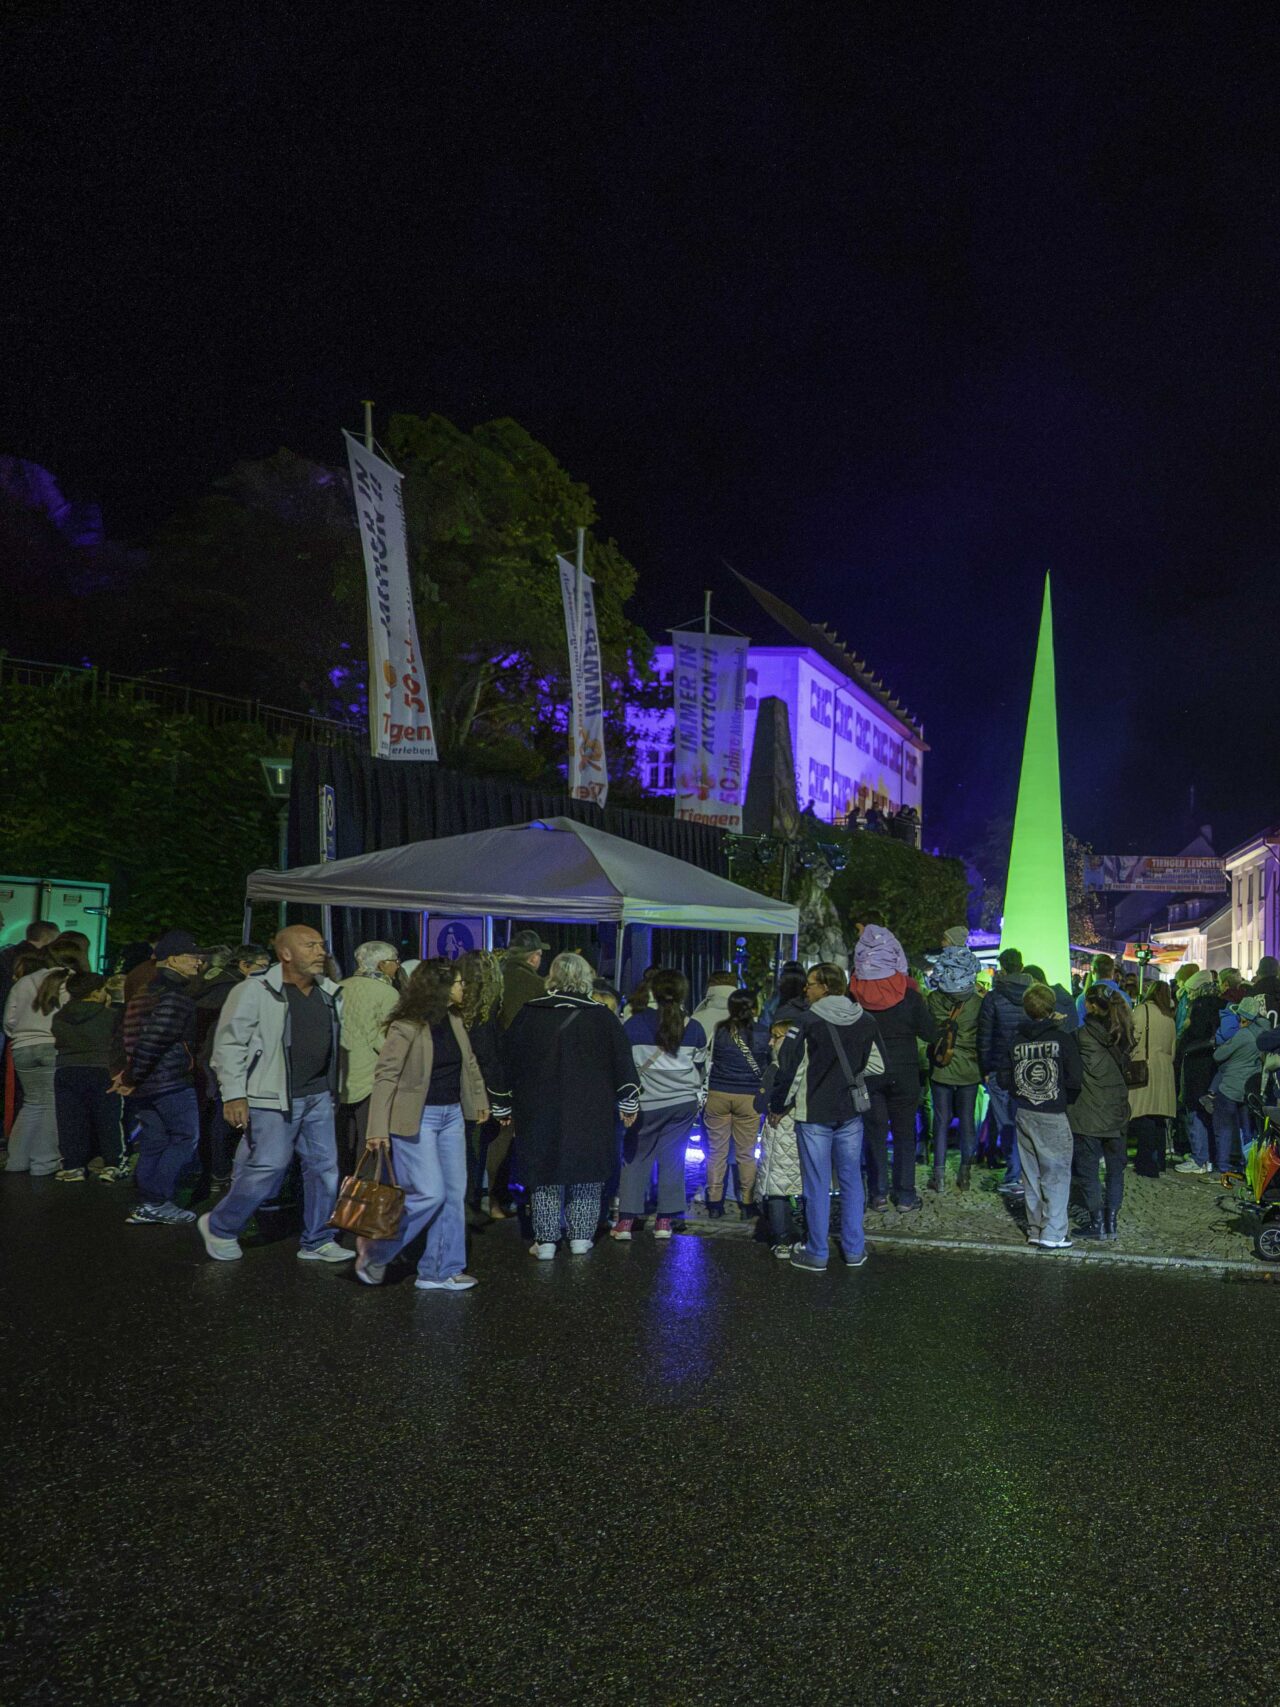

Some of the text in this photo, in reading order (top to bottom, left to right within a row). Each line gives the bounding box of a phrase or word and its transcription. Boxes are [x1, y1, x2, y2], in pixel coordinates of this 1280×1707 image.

[679, 643, 698, 754] IMMER IN
[701, 670, 718, 755] AKTION
[719, 778, 741, 806] 50
[1013, 1042, 1060, 1060] SUTTER
